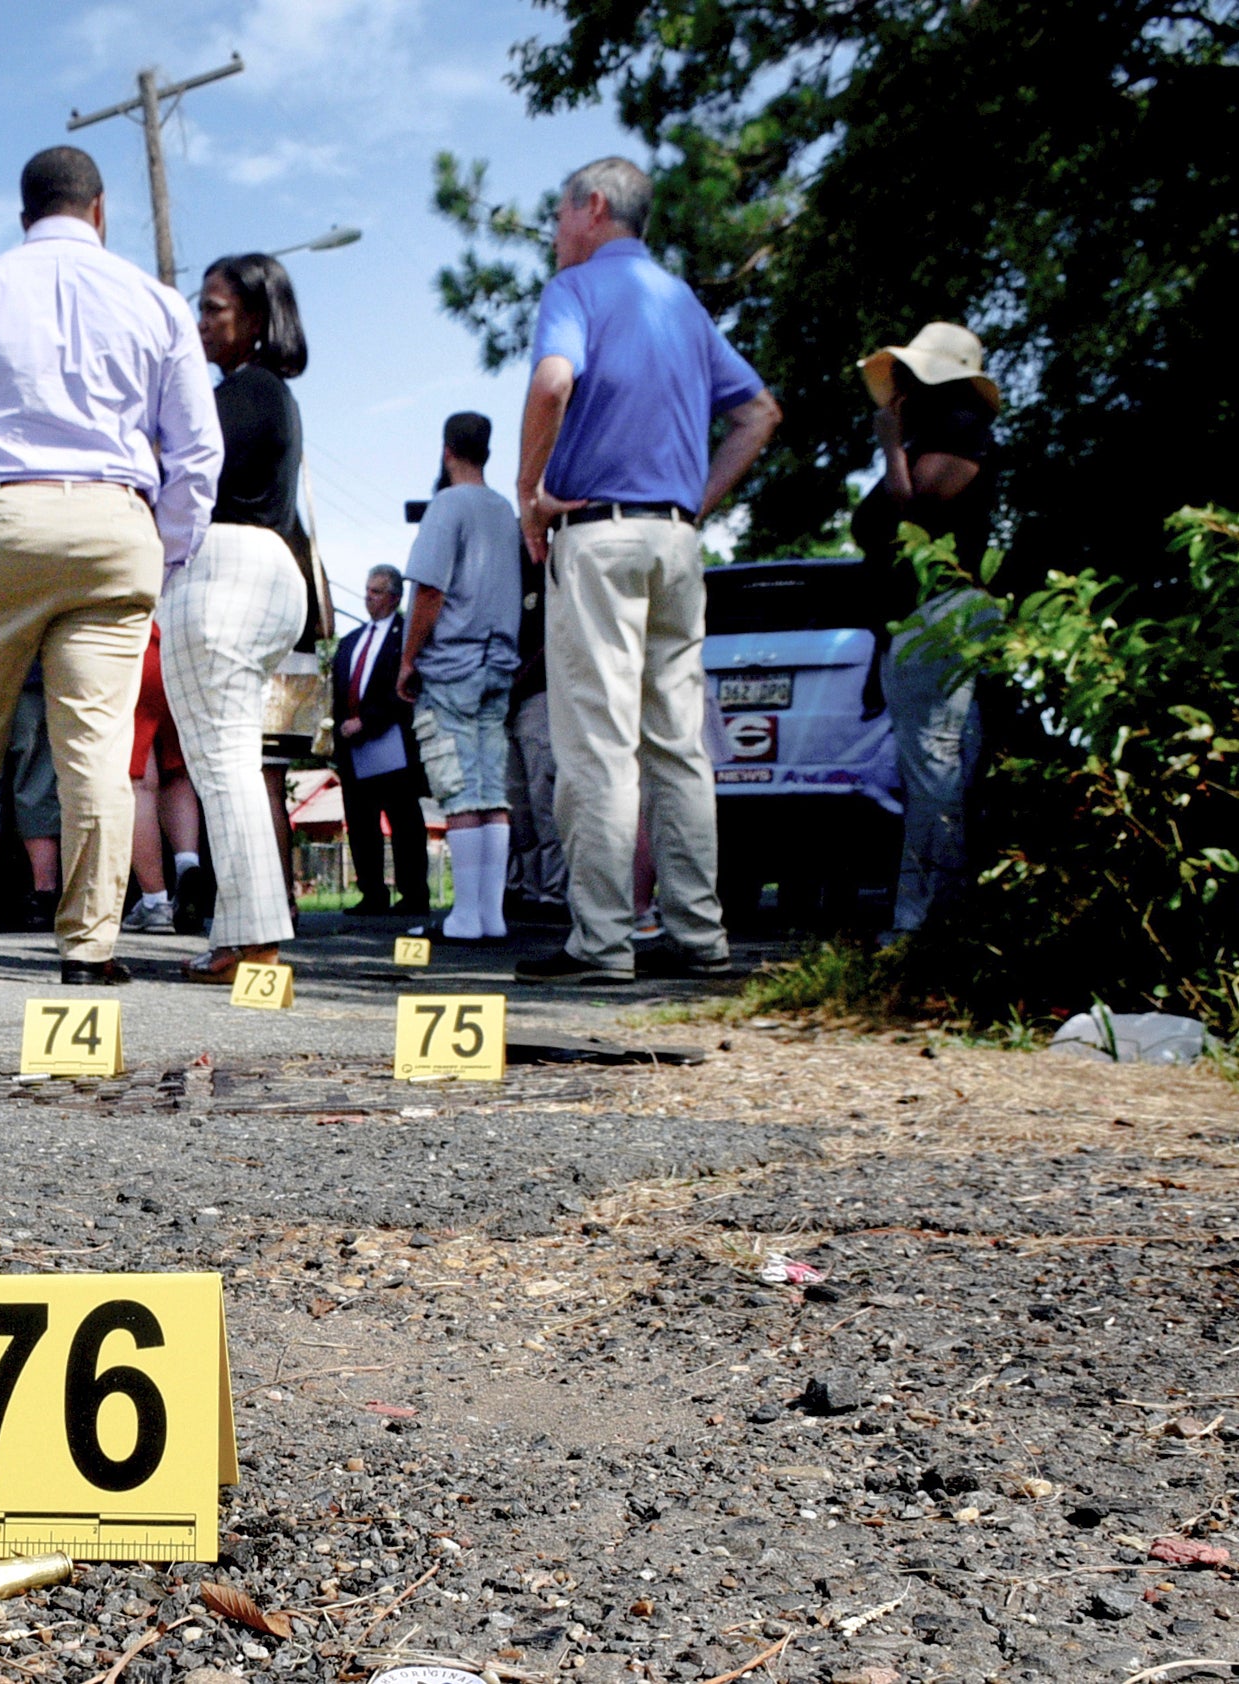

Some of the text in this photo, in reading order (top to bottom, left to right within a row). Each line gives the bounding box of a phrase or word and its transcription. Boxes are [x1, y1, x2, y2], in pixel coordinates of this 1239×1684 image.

[716, 768, 772, 783] NEWS
[401, 941, 423, 959] 72
[244, 968, 277, 997] 73
[41, 1006, 102, 1055] 74
[415, 1004, 484, 1058] 75
[92, 1526, 98, 1534] 2
[187, 1527, 193, 1536] 3
